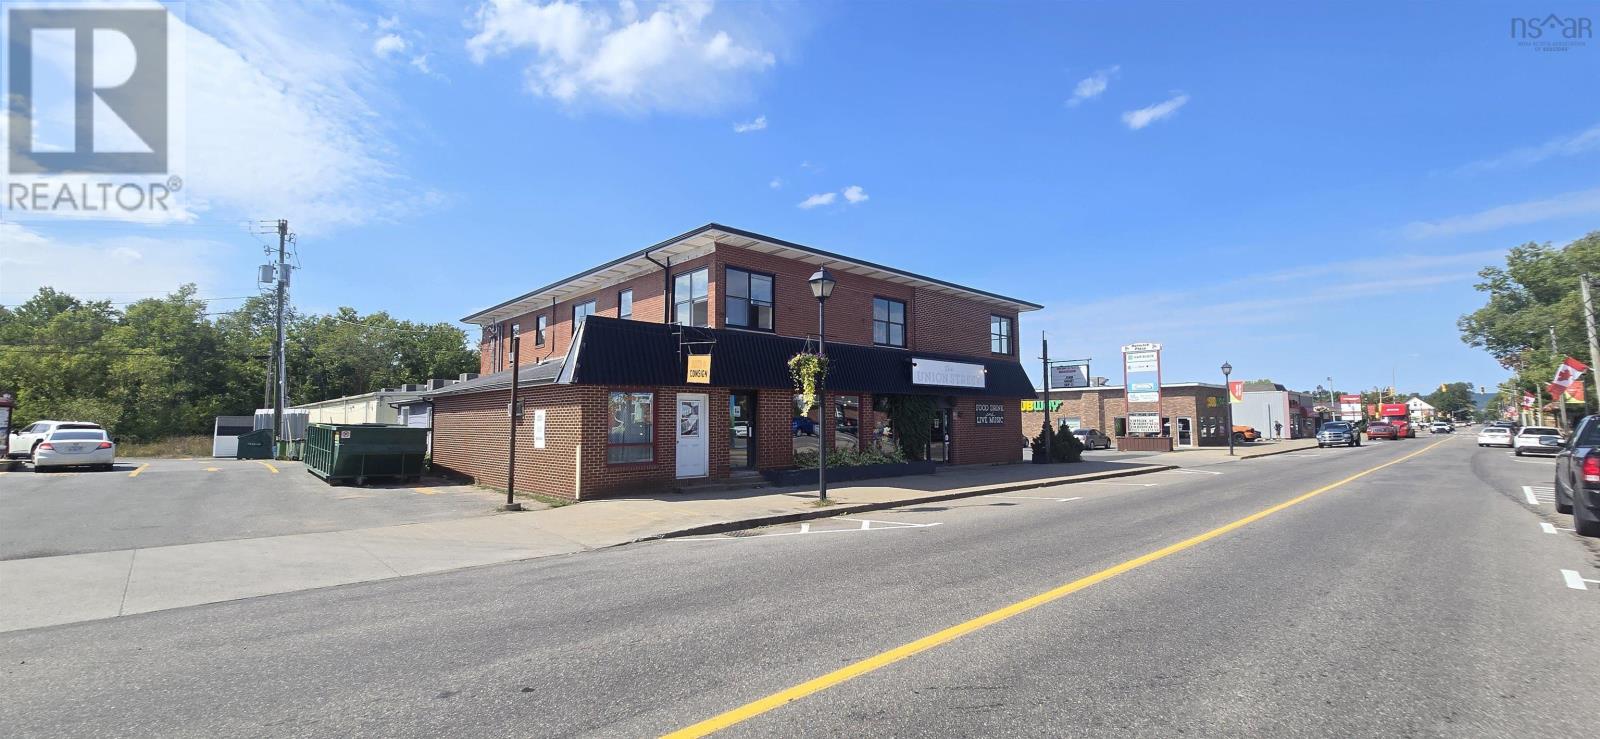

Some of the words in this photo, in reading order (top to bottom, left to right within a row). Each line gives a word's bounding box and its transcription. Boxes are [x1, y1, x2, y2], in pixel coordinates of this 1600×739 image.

[690, 369, 708, 378] CONSIGN
[916, 371, 948, 384] UNION
[975, 404, 989, 412] FOOD
[1020, 399, 1063, 412] UBWY
[976, 416, 988, 424] LIVE
[989, 416, 1004, 424] MUSIC
